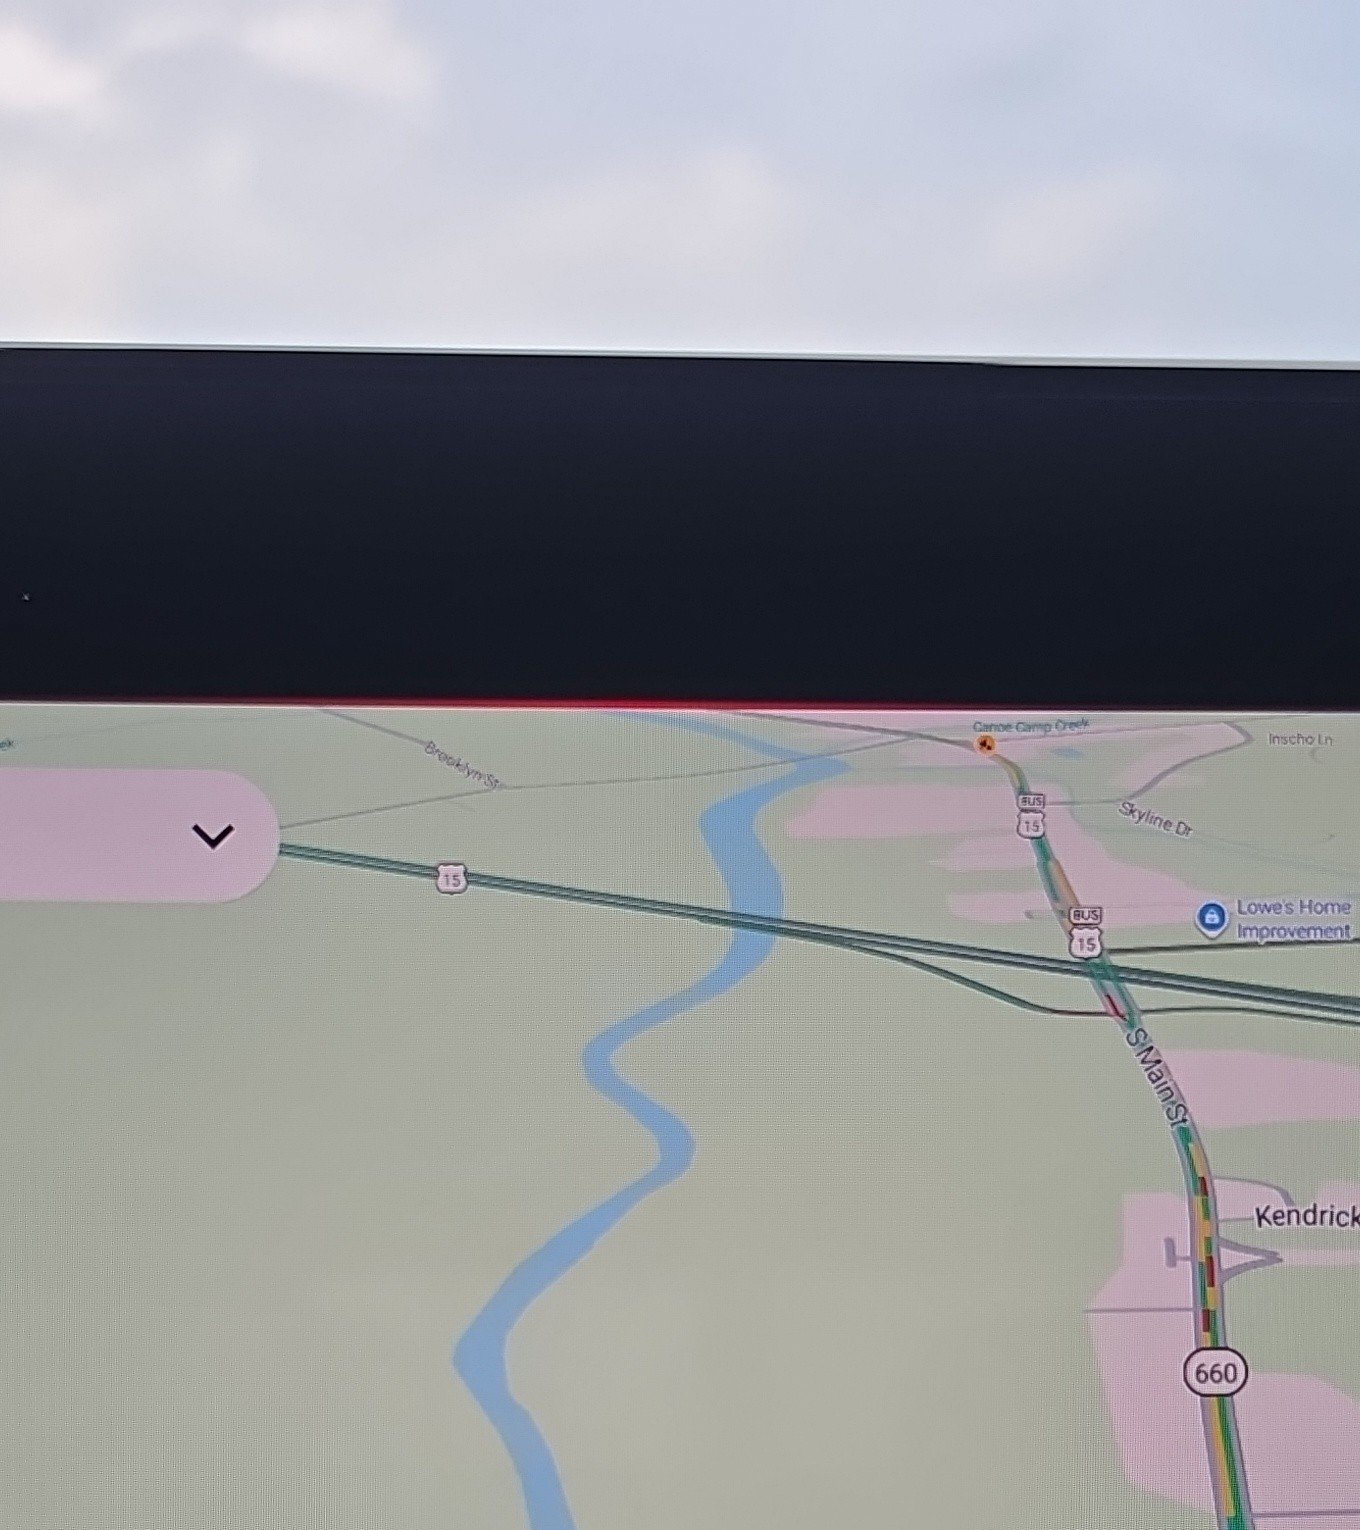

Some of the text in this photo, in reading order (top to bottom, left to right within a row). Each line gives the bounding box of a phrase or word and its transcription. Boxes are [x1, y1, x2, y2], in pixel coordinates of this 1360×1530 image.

[973, 717, 1090, 735] Canoe Camp Creek
[1268, 732, 1333, 747] Inscho Ln
[424, 740, 482, 780] Brooklyn
[1020, 796, 1042, 807] BUS
[1024, 820, 1040, 833] 15
[1118, 800, 1193, 838] Skyline Dr
[443, 873, 461, 887] 15
[1073, 909, 1100, 922] BUS
[1237, 899, 1352, 916] Lowe's Home
[1237, 924, 1351, 943] Improvement
[1078, 936, 1096, 951] 15
[1126, 1027, 1189, 1127] S Main St
[1195, 1363, 1238, 1384] 660
